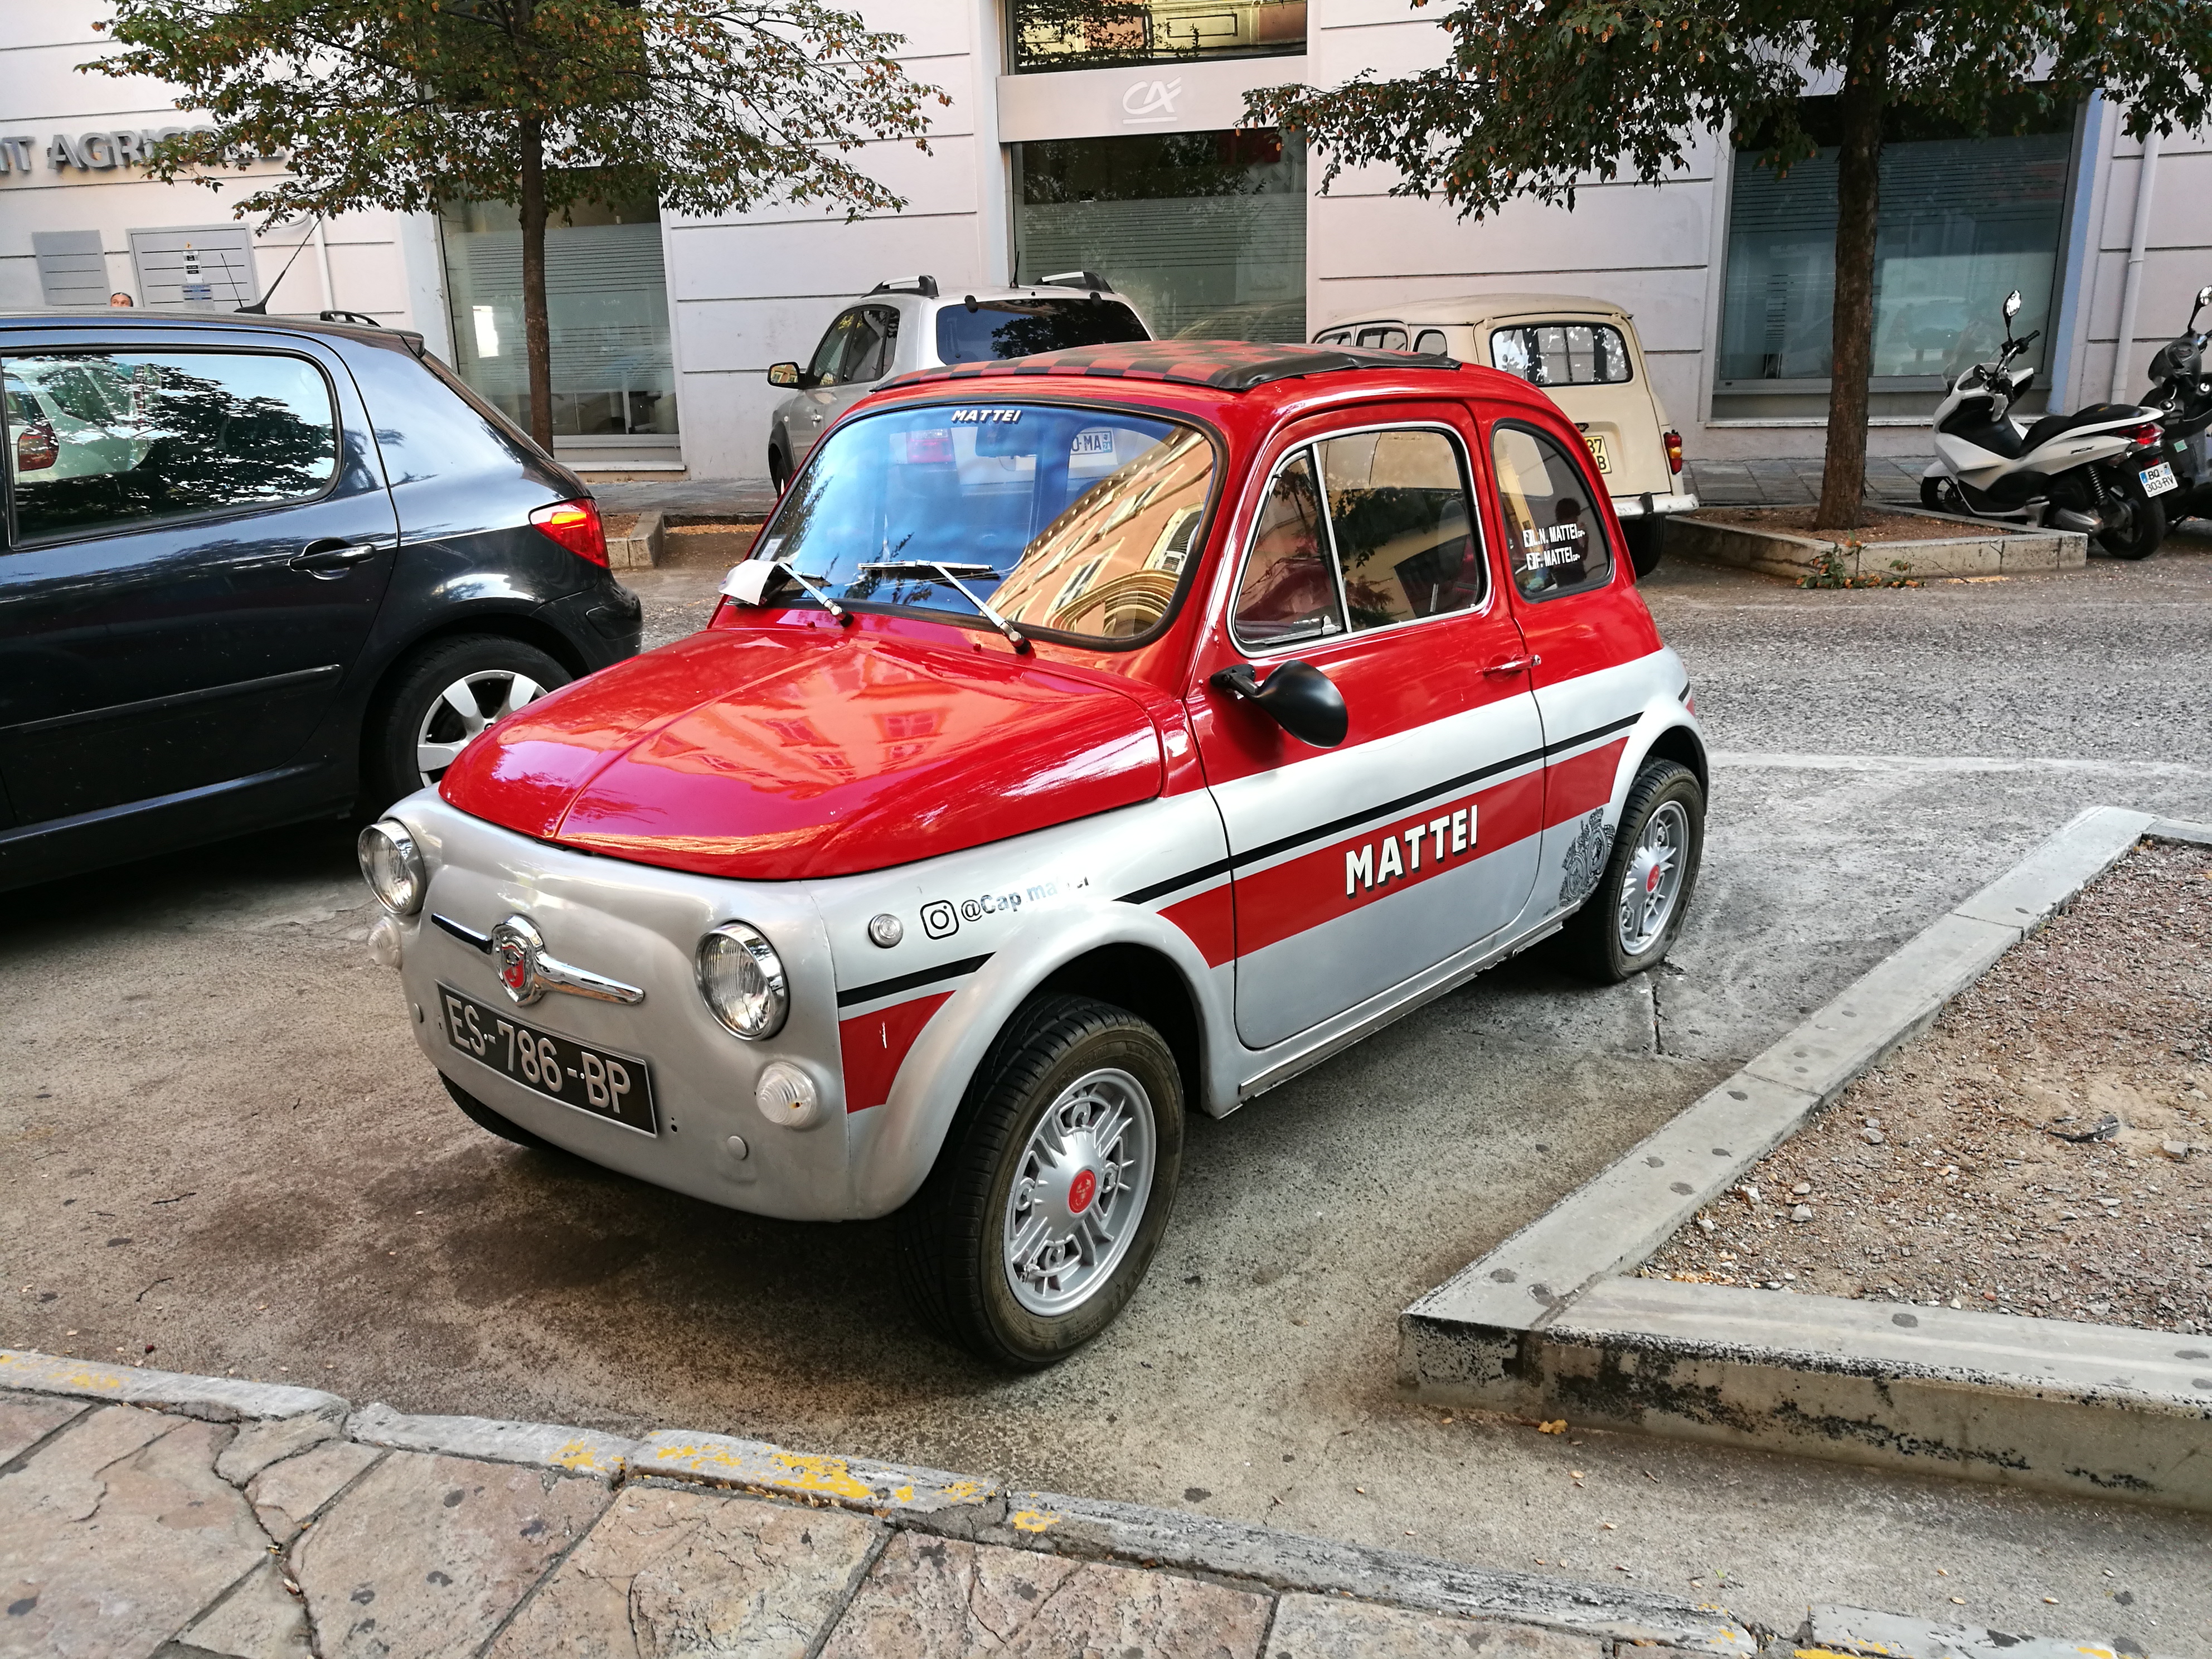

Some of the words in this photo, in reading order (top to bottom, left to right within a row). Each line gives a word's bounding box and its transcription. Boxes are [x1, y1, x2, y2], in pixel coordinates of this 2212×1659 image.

[951, 410, 1022, 424] MATTEI
[2146, 475, 2174, 492] 303-RV
[1549, 523, 1578, 542] MATTEI
[1543, 546, 1573, 567] MATTEI
[1345, 804, 1478, 898] MATTEI
[961, 891, 1022, 921] @Cap
[445, 995, 631, 1114] ES-786-BP
